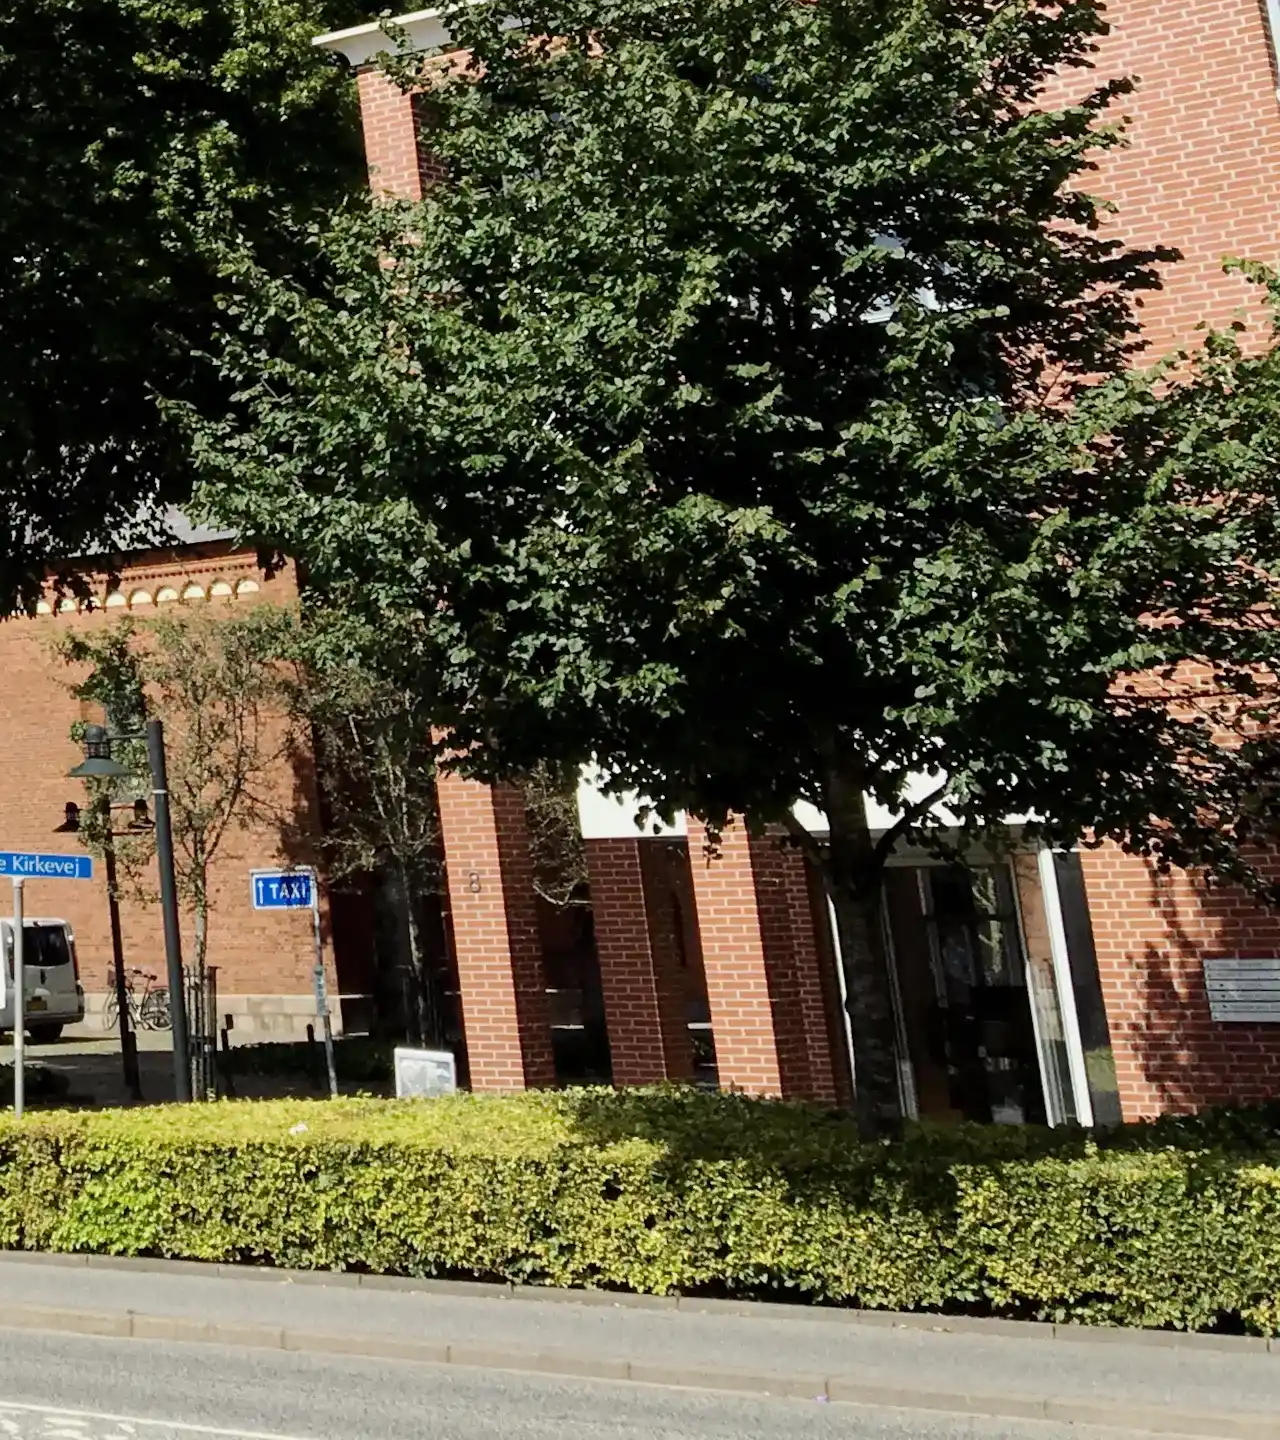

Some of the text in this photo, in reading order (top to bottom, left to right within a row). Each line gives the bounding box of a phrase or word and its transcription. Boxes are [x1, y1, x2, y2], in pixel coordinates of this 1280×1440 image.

[12, 855, 80, 878] Kirkevej
[269, 882, 307, 899] TAXI
[469, 872, 482, 893] 8
